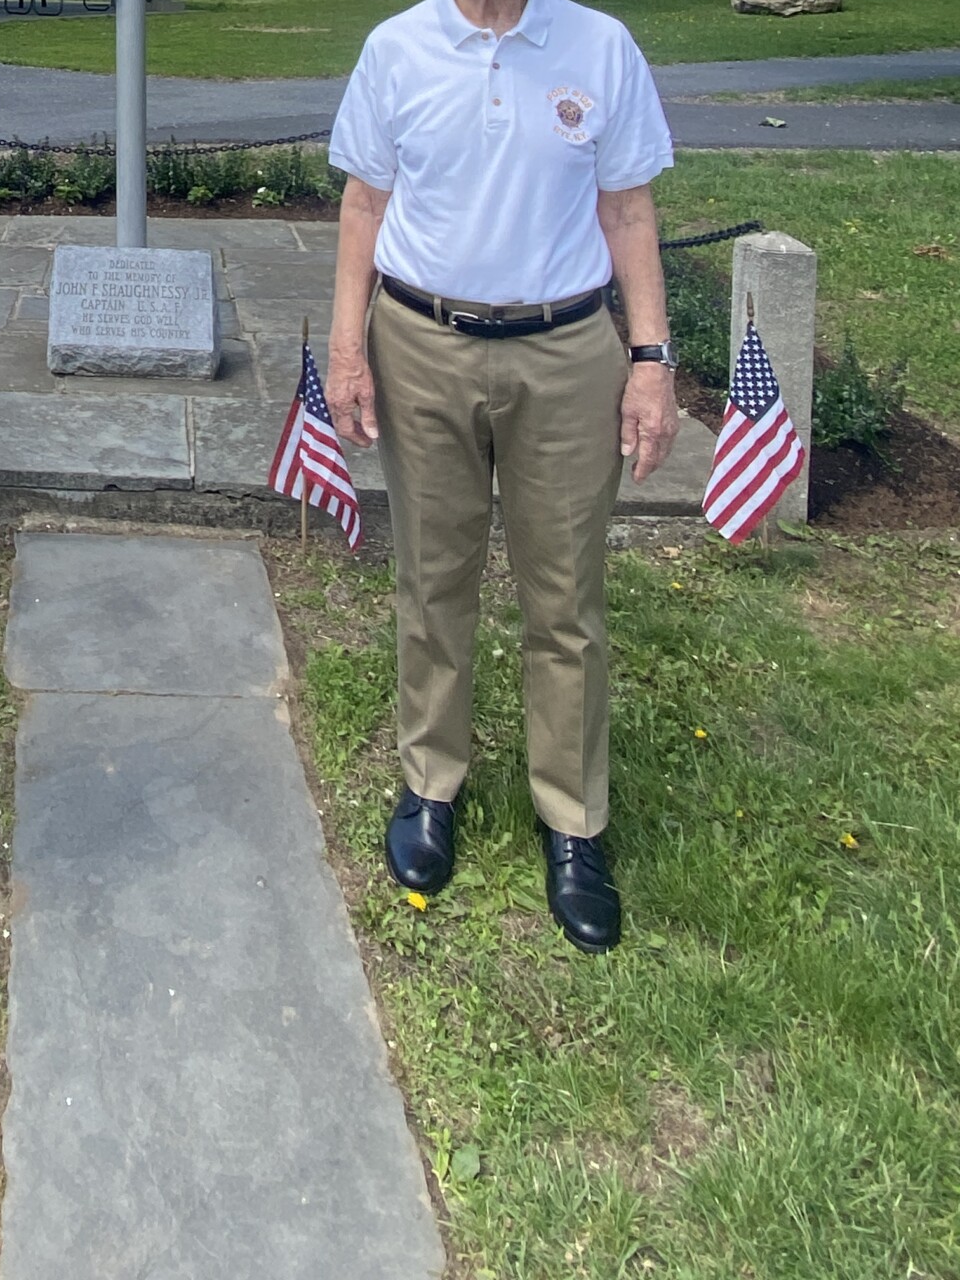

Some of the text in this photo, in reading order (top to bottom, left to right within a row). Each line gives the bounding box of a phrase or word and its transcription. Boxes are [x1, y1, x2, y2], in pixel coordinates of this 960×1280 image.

[547, 86, 569, 102] POST
[109, 259, 156, 270] DEDICATED
[88, 271, 177, 283] TO THE MEMORY OF
[55, 282, 87, 296] JOHN
[101, 283, 189, 300] SHAUGHNESSY
[80, 298, 125, 311] CAPTAIN
[82, 312, 179, 326] HE SERVES GOD WELL
[71, 325, 191, 340] WHO SERVES HIS COUNTRY
